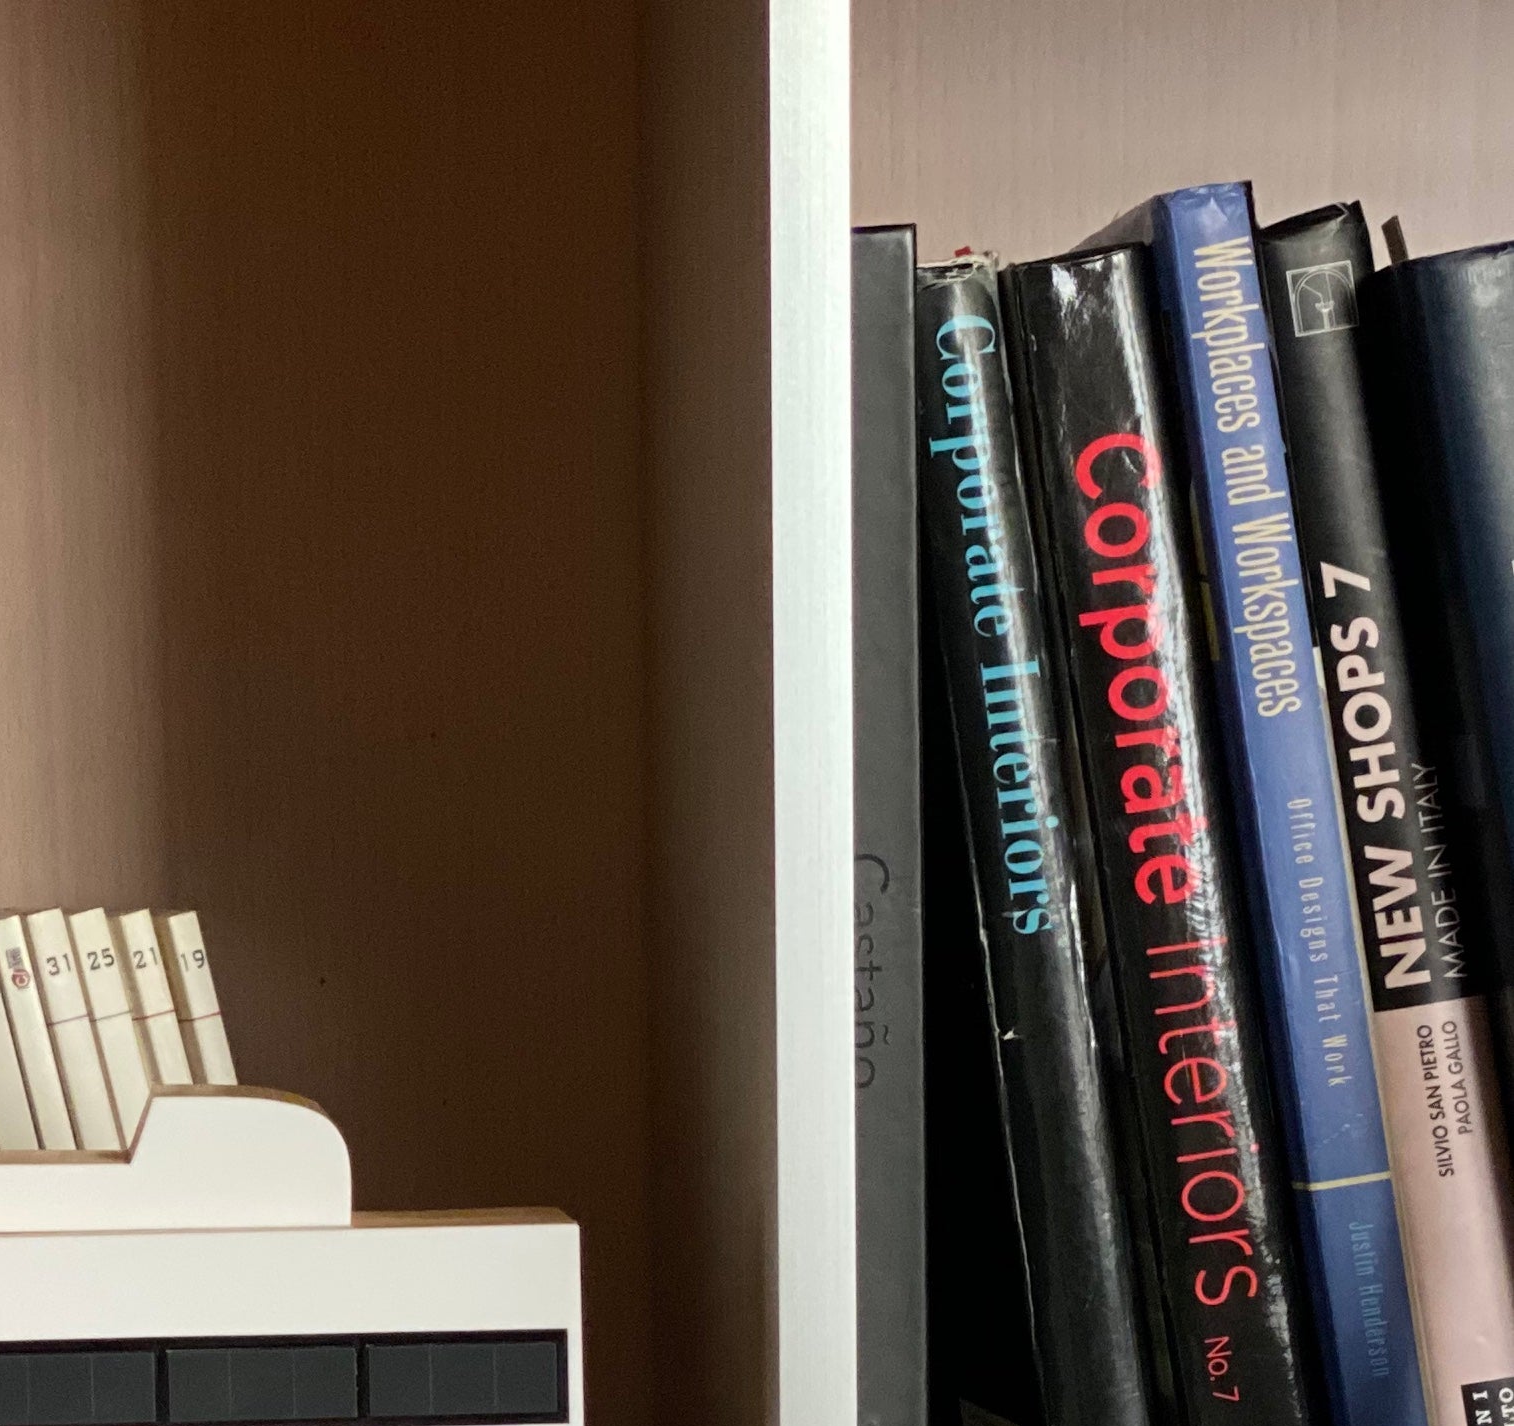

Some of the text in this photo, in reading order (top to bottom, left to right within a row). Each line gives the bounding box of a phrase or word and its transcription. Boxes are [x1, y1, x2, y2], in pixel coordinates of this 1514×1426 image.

[1191, 236, 1302, 717] Workplaces and Workspaces
[929, 314, 1059, 935] Corporate Interiors
[1320, 561, 1431, 990] NEW SHOPS 7
[1076, 433, 1258, 1402] Corporate Interiors No. 7
[1287, 797, 1353, 1088] Office Designs That Work
[1411, 762, 1468, 980] MADE IN ITALY
[46, 953, 72, 976] 31
[87, 948, 115, 971] 25
[133, 946, 159, 969] 21
[180, 948, 206, 972] 19
[1417, 1024, 1455, 1178] SILVIO SAN PIETRO
[1441, 1020, 1473, 1135] PAOLA GALLO
[1348, 1221, 1390, 1378] Justin Henderson
